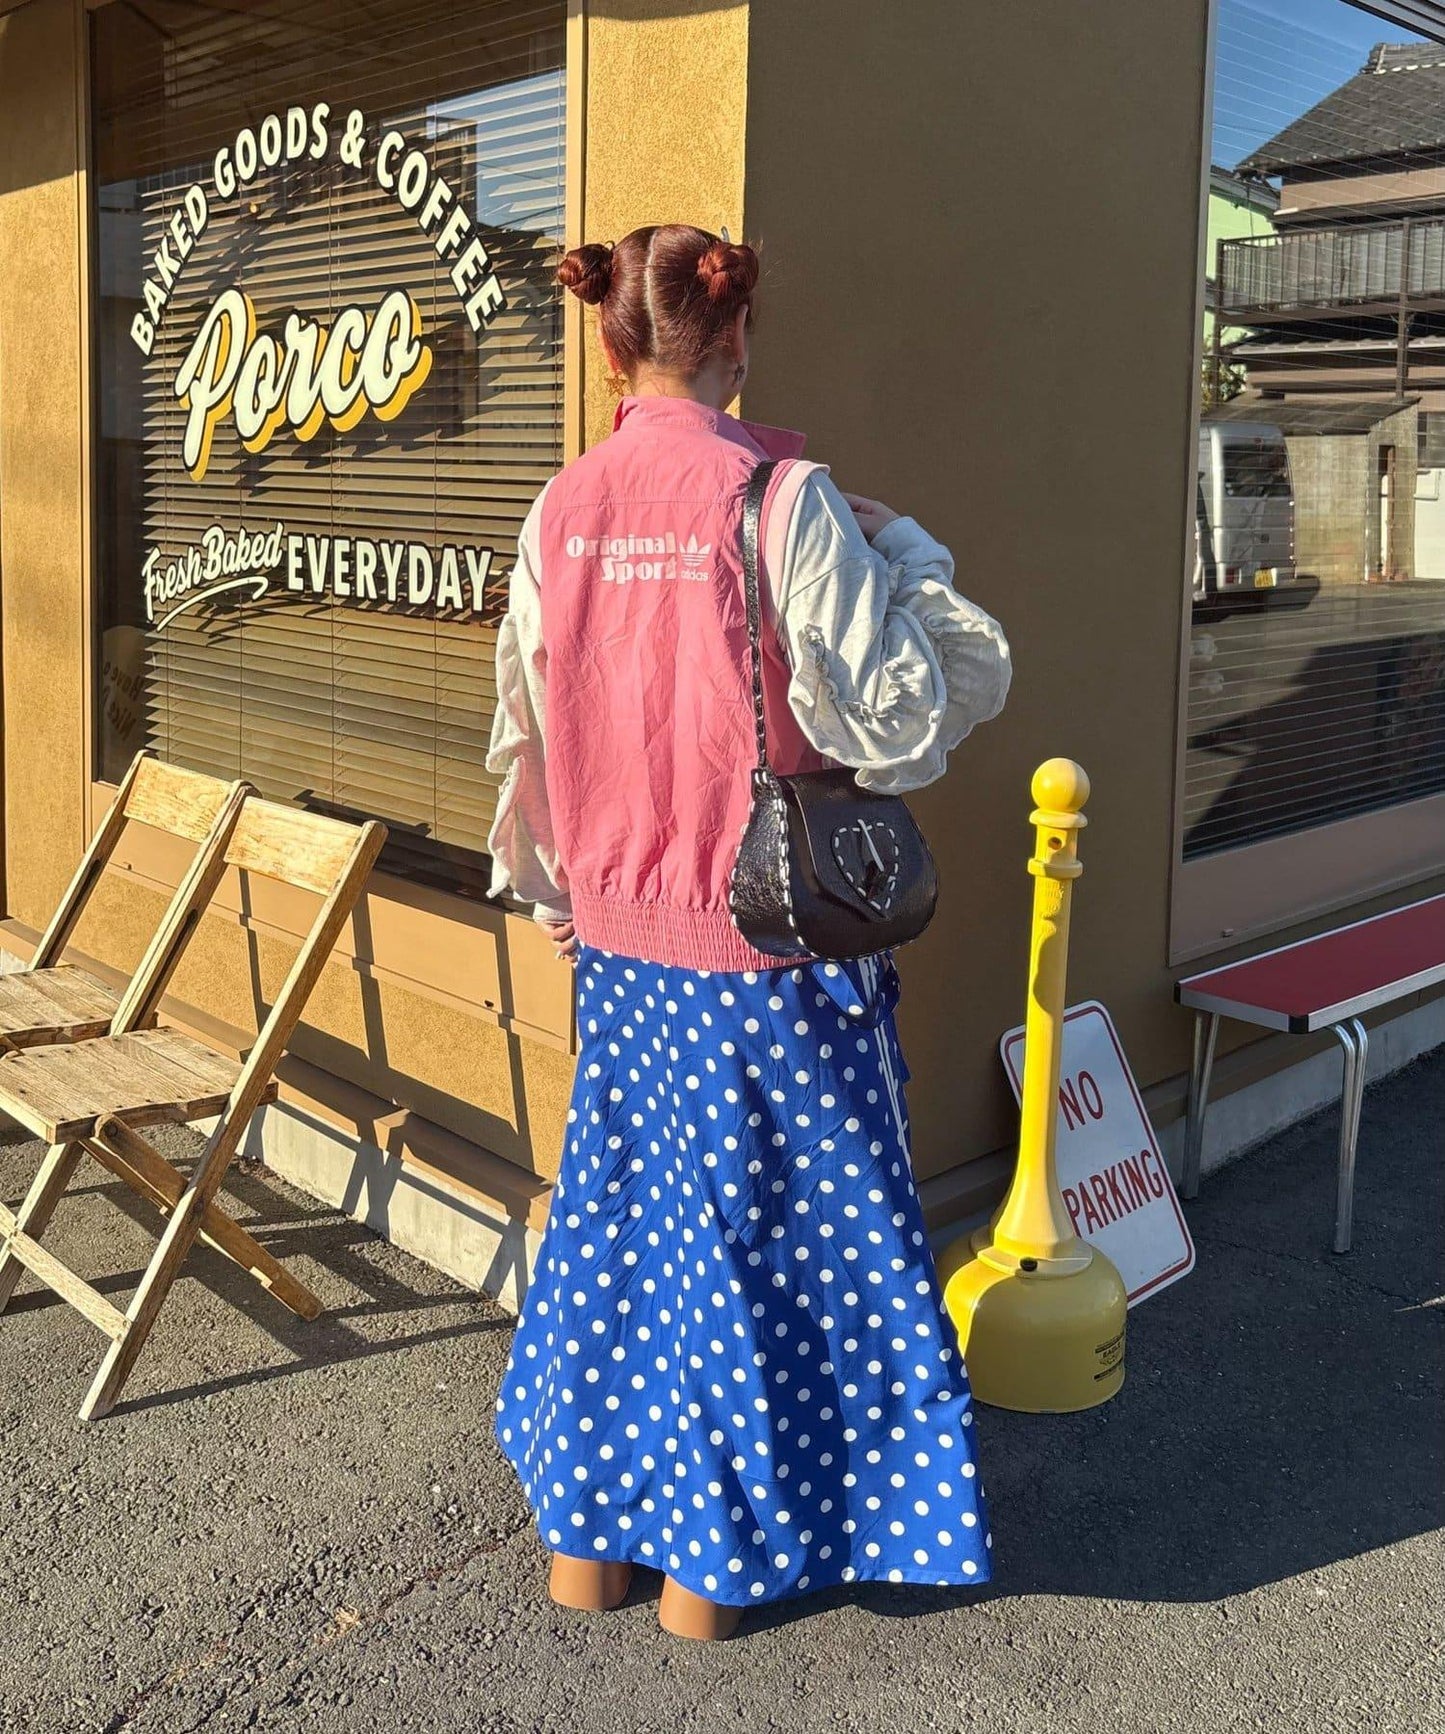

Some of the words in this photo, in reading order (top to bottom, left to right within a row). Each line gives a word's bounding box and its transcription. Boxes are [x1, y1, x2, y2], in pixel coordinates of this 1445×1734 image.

[130, 184, 208, 356] BAKED
[214, 102, 330, 199] GOODS
[339, 108, 366, 169] &
[376, 130, 504, 332] COFFEE
[174, 289, 433, 481] Porco
[141, 547, 204, 621] Fresh
[202, 522, 284, 580] Baked
[287, 535, 493, 612] EVERYDAY
[565, 532, 676, 563] Original
[601, 556, 677, 585] Sport
[680, 567, 710, 582] adidas
[1059, 1070, 1104, 1131] NO
[1062, 1148, 1164, 1239] PARKING
